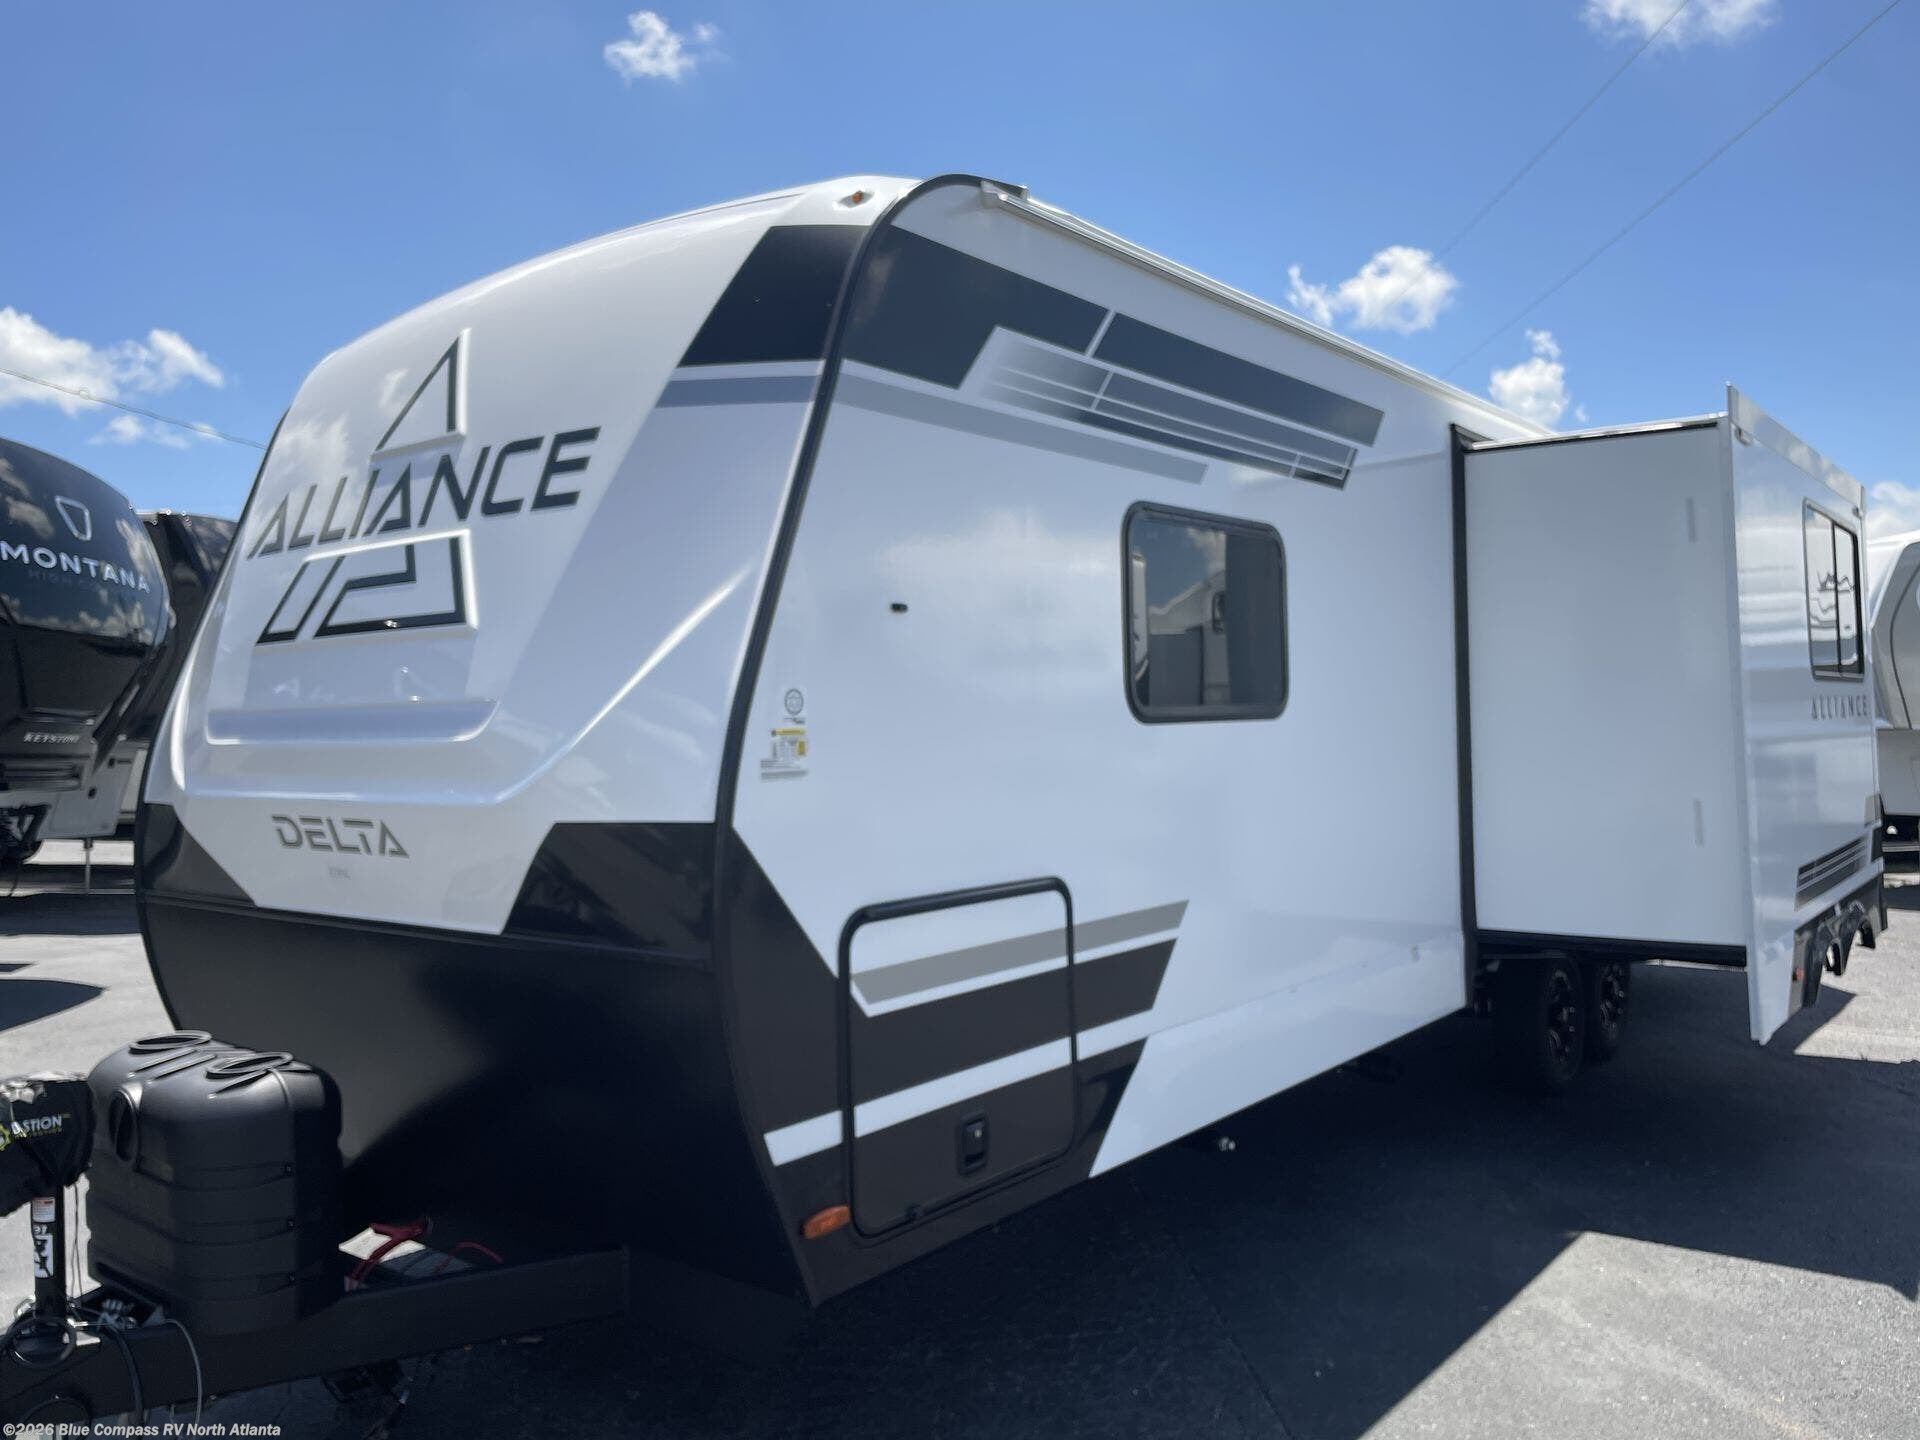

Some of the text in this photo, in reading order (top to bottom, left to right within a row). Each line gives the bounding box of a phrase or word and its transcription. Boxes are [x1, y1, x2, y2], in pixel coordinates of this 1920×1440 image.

[247, 426, 602, 559] ALLIANCE
[0, 541, 151, 594] MONTANA
[1811, 694, 1868, 719] ALLIANCE
[272, 814, 410, 859] DELTA
